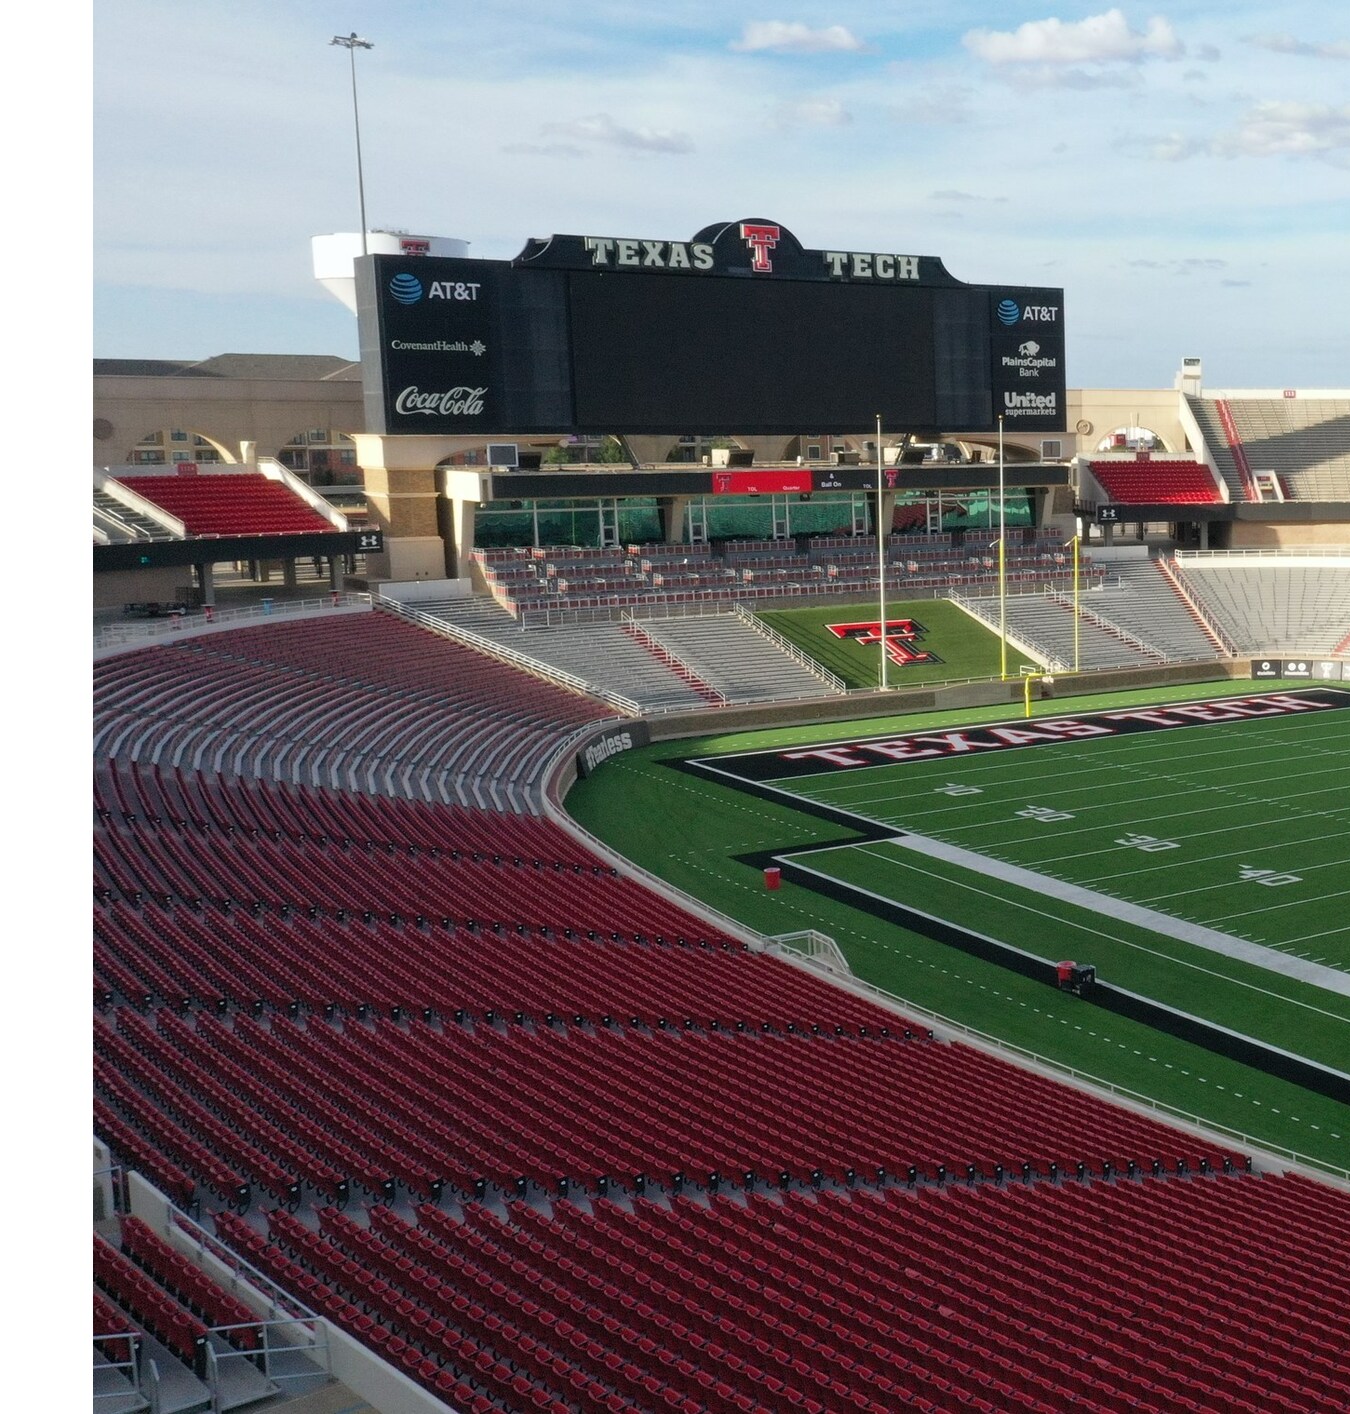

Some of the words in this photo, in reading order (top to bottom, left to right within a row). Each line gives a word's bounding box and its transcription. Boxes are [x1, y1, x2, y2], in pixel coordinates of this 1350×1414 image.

[585, 237, 714, 270] TEXAS
[824, 252, 919, 280] TECH
[429, 282, 480, 300] AT&T
[1023, 306, 1058, 321] AT&T
[391, 340, 468, 351] CovenantHealth
[1002, 357, 1056, 367] PlainsCapital
[1019, 368, 1039, 376] Bank
[396, 386, 488, 415] Coca-Cola
[1004, 392, 1056, 407] United
[1005, 408, 1056, 417] supermarkets
[783, 720, 1113, 768] TEXAS
[1105, 695, 1333, 727] TECH
[1015, 807, 1076, 823] 20
[1114, 834, 1181, 852] 30
[1239, 869, 1303, 887] 40
